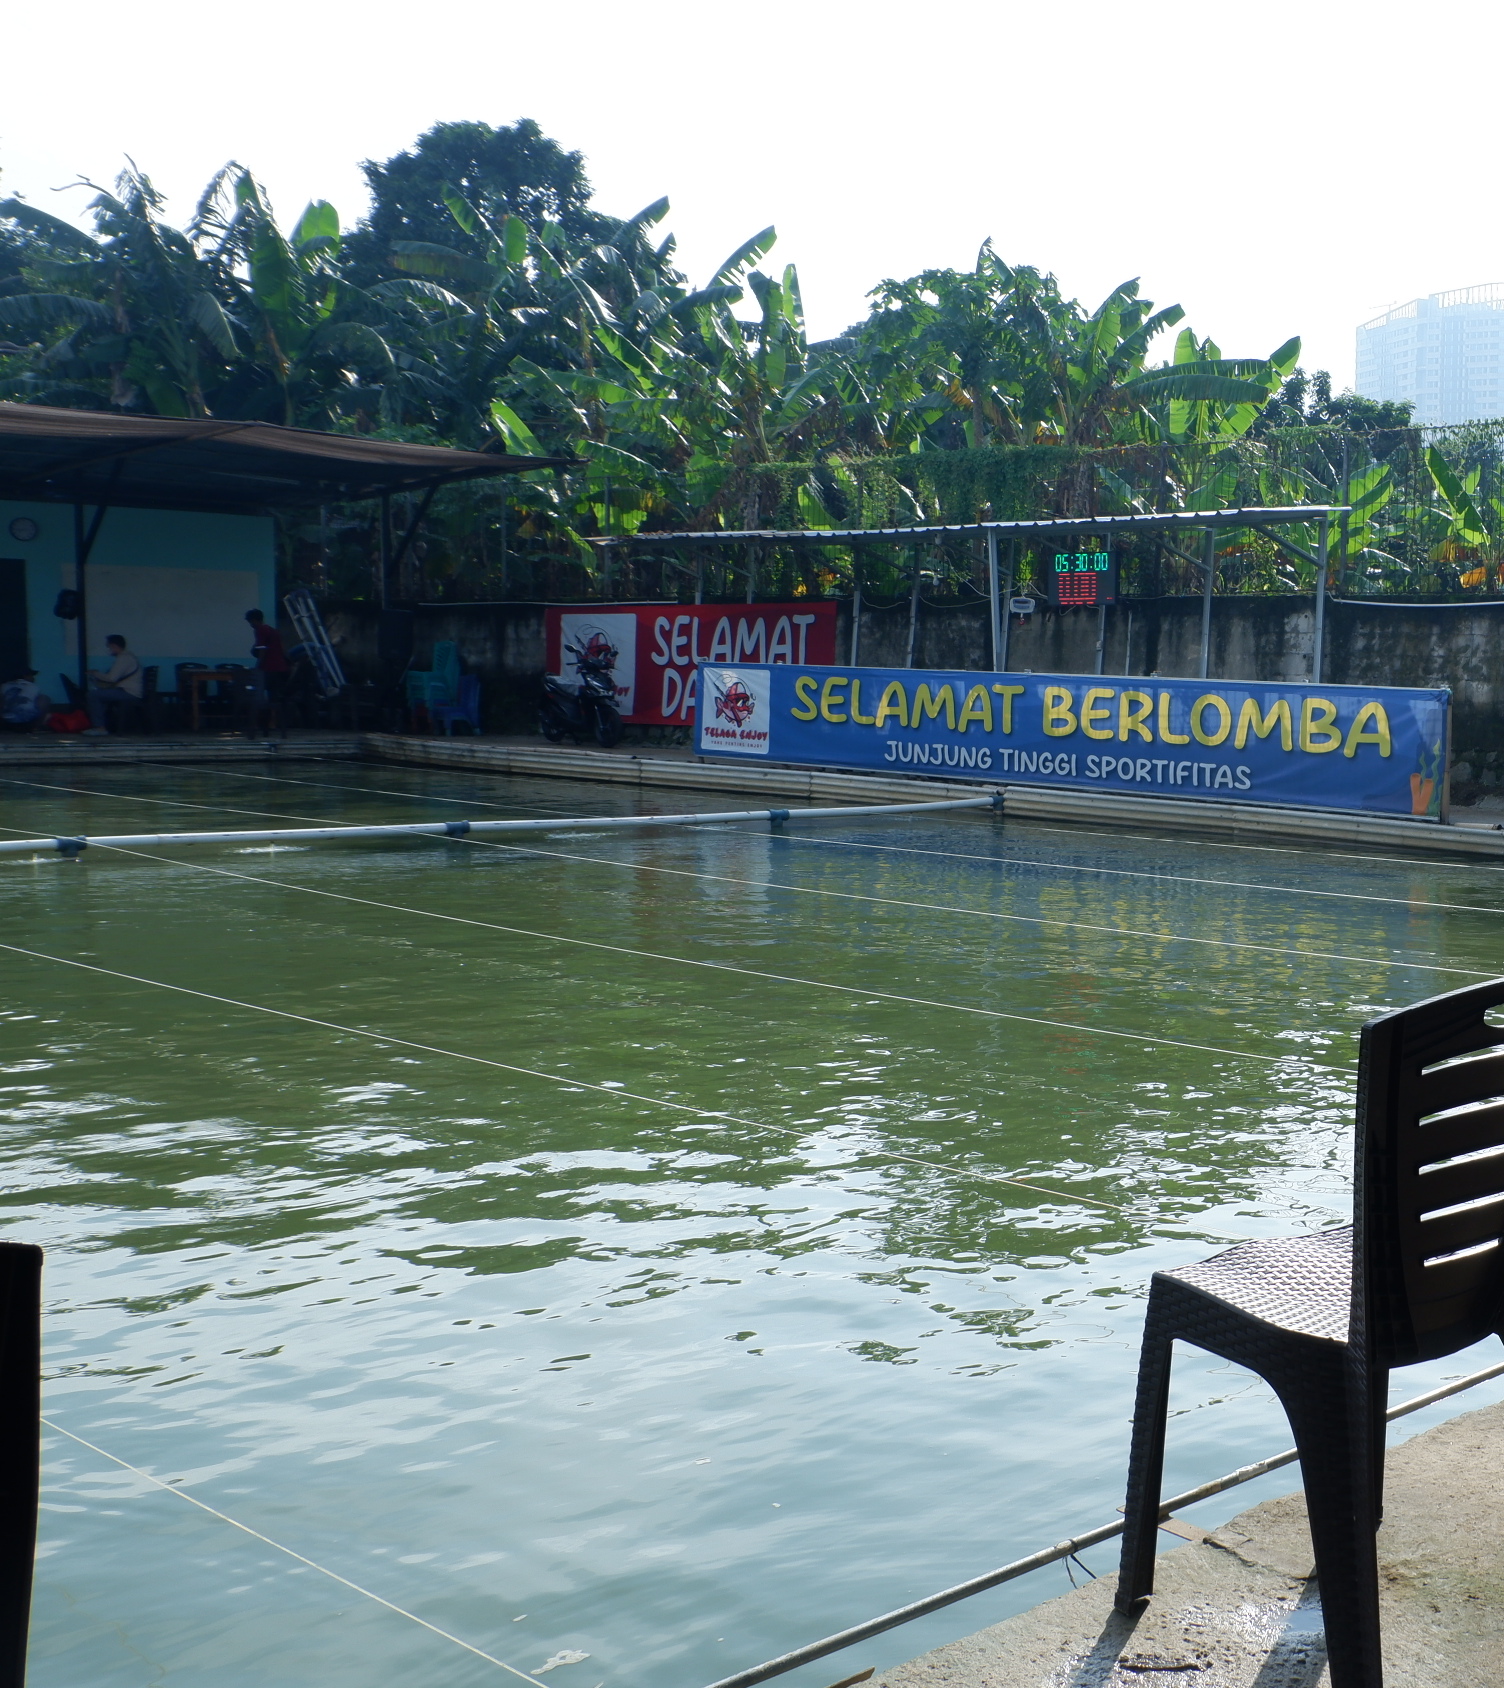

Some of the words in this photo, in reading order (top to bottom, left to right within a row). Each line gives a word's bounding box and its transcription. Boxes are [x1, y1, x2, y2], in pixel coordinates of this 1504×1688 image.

[1055, 552, 1108, 572] 05:30:00
[651, 614, 815, 665] SELAMAT
[704, 727, 737, 739] TELAGA
[739, 729, 768, 741] ENJOY
[791, 676, 1025, 734] SELAMAT
[1042, 686, 1392, 758] BERLOMBA
[884, 740, 993, 769] JUNJUNG
[999, 748, 1077, 776] TINGGI
[1085, 754, 1251, 790] SPORTIFITAS
